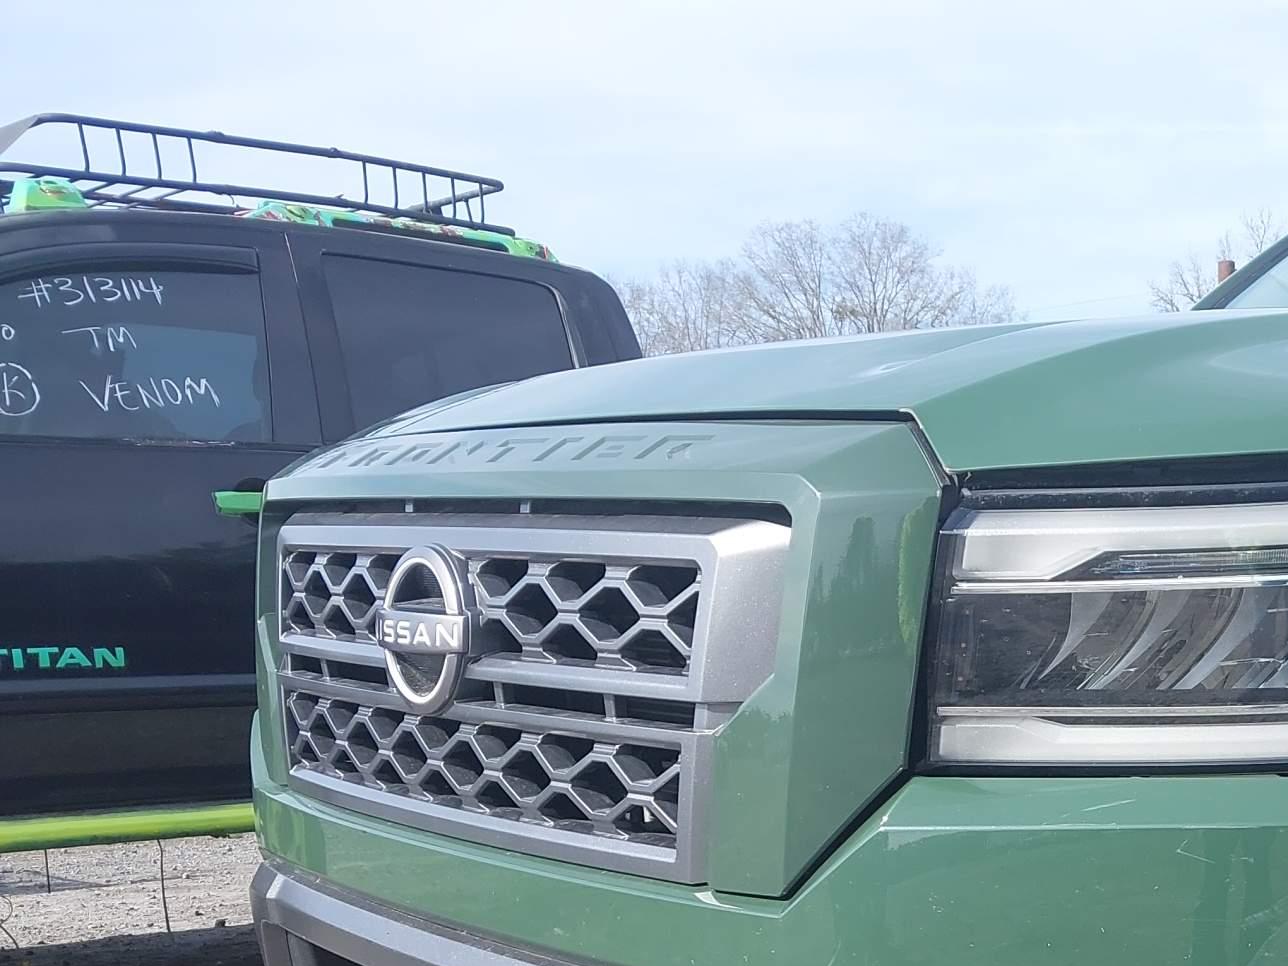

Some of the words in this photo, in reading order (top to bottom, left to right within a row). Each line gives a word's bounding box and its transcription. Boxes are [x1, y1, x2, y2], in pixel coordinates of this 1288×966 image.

[61, 326, 137, 352] TM
[79, 374, 220, 412] VENOM
[378, 619, 459, 647] ISSAN
